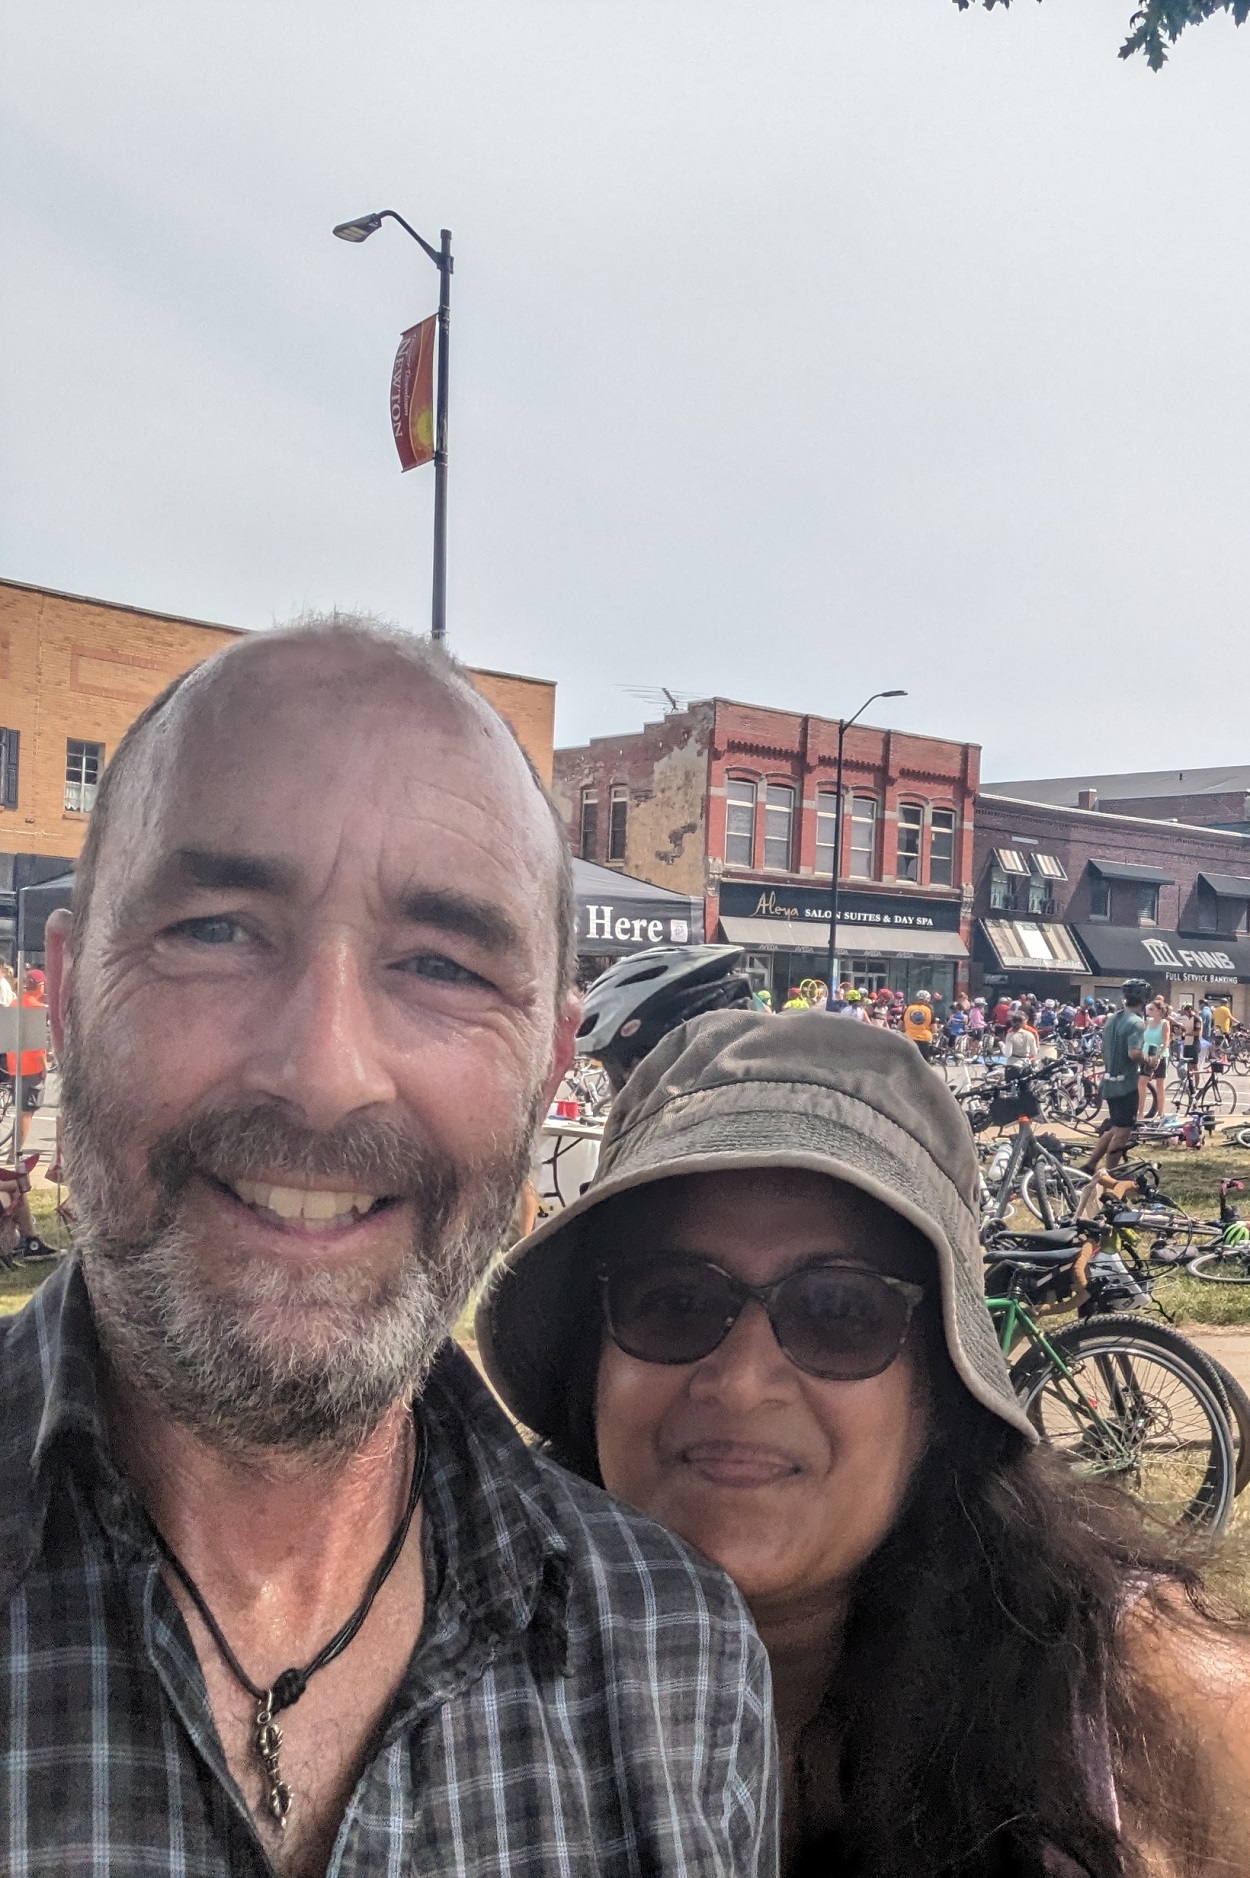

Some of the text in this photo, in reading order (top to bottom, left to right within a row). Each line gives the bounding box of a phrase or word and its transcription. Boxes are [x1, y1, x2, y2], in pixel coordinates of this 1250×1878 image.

[391, 337, 411, 437] NEWTON
[585, 905, 664, 942] Here
[844, 909, 880, 922] SUITES
[883, 915, 891, 923] &
[894, 915, 914, 925] DAY
[916, 918, 934, 926] SPA
[1178, 949, 1235, 969] FNNB
[1165, 972, 1238, 984] FULL SERVICE BANKING
